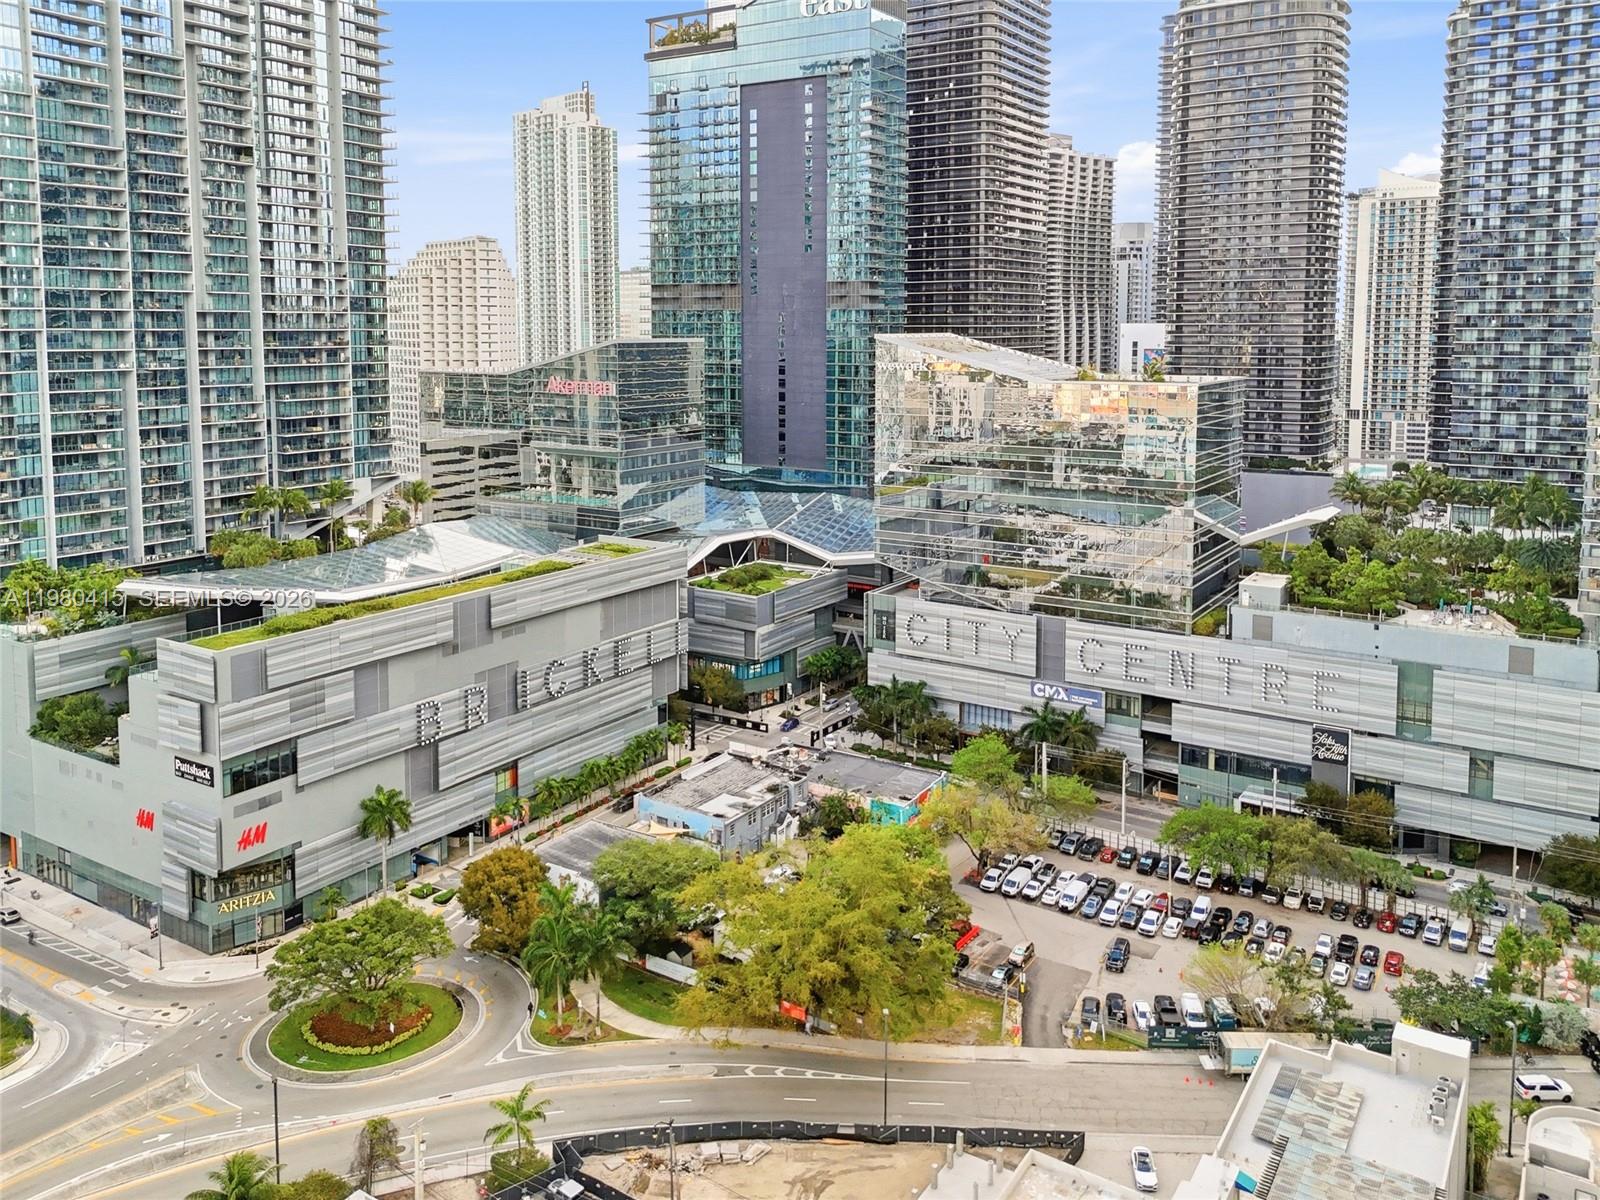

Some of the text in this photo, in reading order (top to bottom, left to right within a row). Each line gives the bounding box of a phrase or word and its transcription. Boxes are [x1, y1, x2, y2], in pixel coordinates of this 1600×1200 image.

[545, 376, 616, 396] Akerman
[905, 613, 1342, 714] CITY CENTRE
[416, 622, 688, 747] BRICKELL
[1033, 683, 1068, 701] CMX
[1312, 732, 1336, 745] Saks
[1312, 745, 1345, 761] Avenue
[175, 759, 211, 780] Puttshack
[218, 890, 276, 913] ARITZIA
